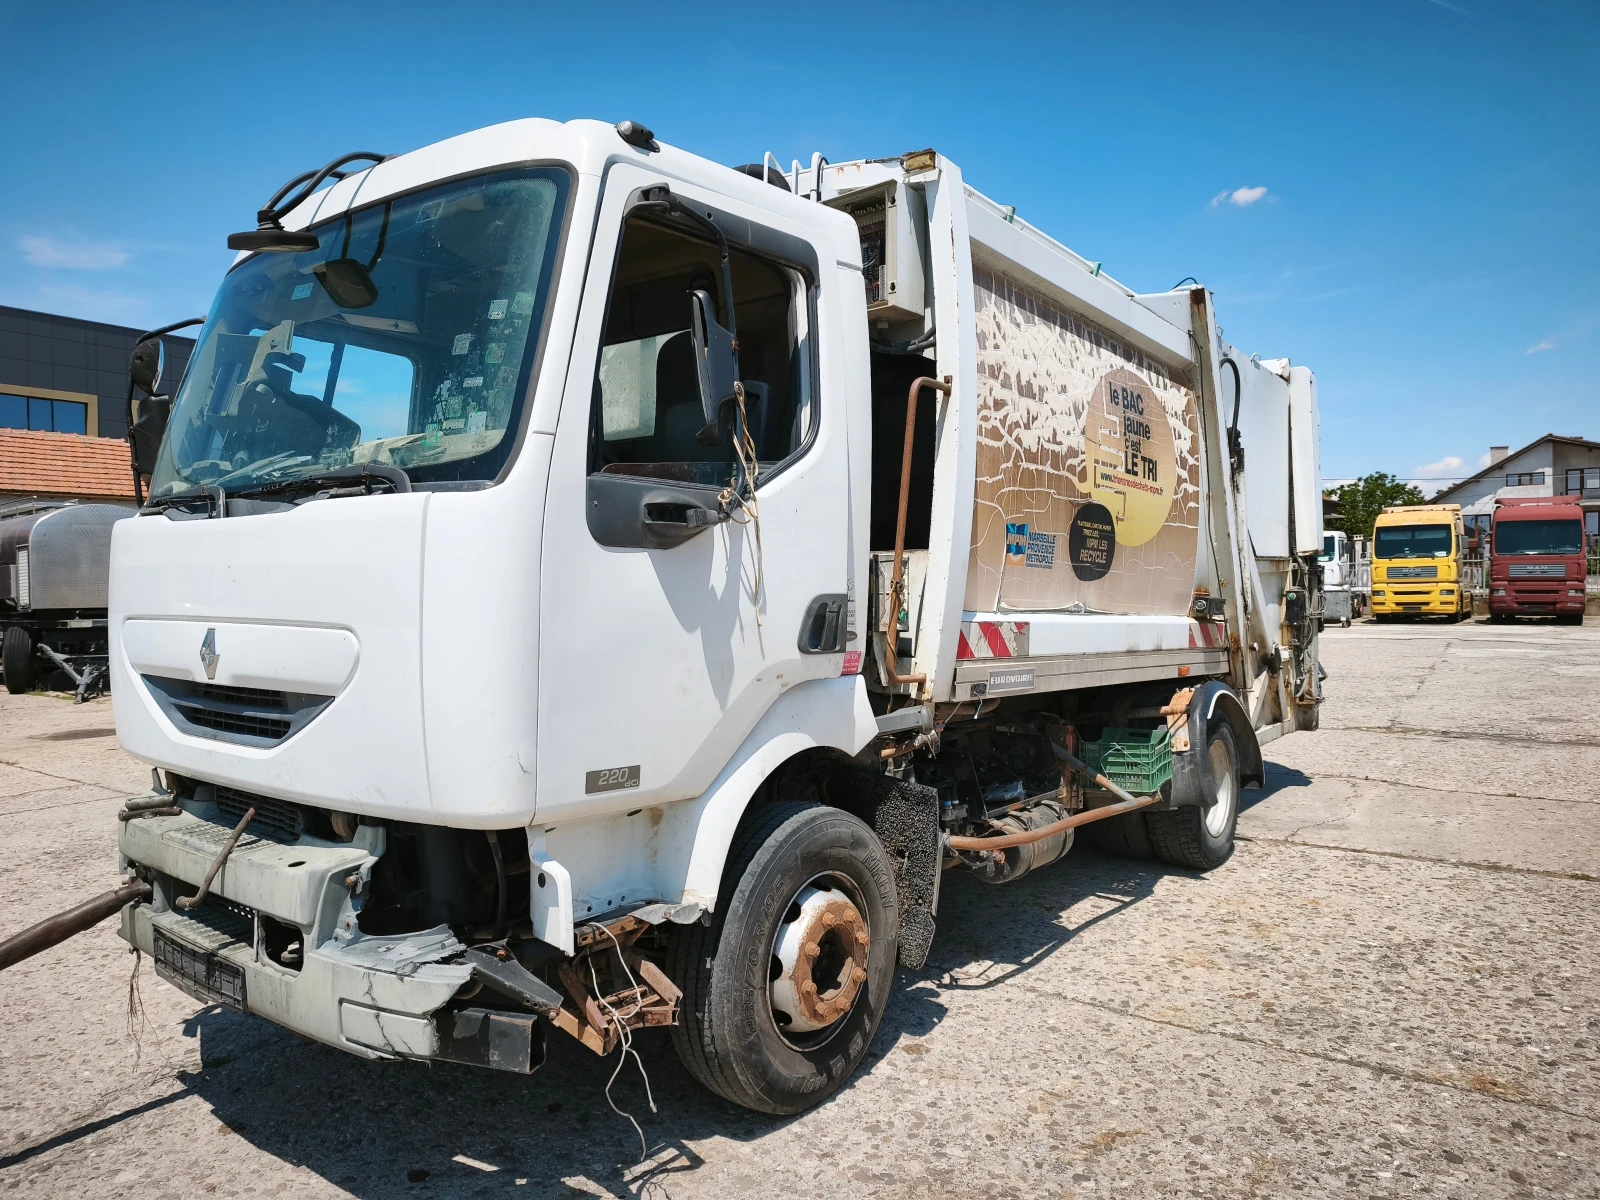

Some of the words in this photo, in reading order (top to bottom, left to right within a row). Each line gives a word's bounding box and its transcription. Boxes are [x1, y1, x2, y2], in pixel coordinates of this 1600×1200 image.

[1109, 381, 1119, 406] le
[1121, 386, 1144, 416] BAC
[1123, 410, 1151, 440] jaune
[1124, 436, 1142, 454] c'est
[1124, 451, 1138, 477] LE
[1140, 455, 1158, 482] TRI
[1028, 531, 1056, 545] MARSEILLE
[1099, 540, 1108, 551] LES
[1027, 542, 1055, 555] PROVENCE
[1080, 548, 1107, 563] RECYCLE
[990, 673, 1034, 685] EUROVOIRIE
[599, 767, 629, 785] 220
[862, 845, 894, 909] RIKEN
